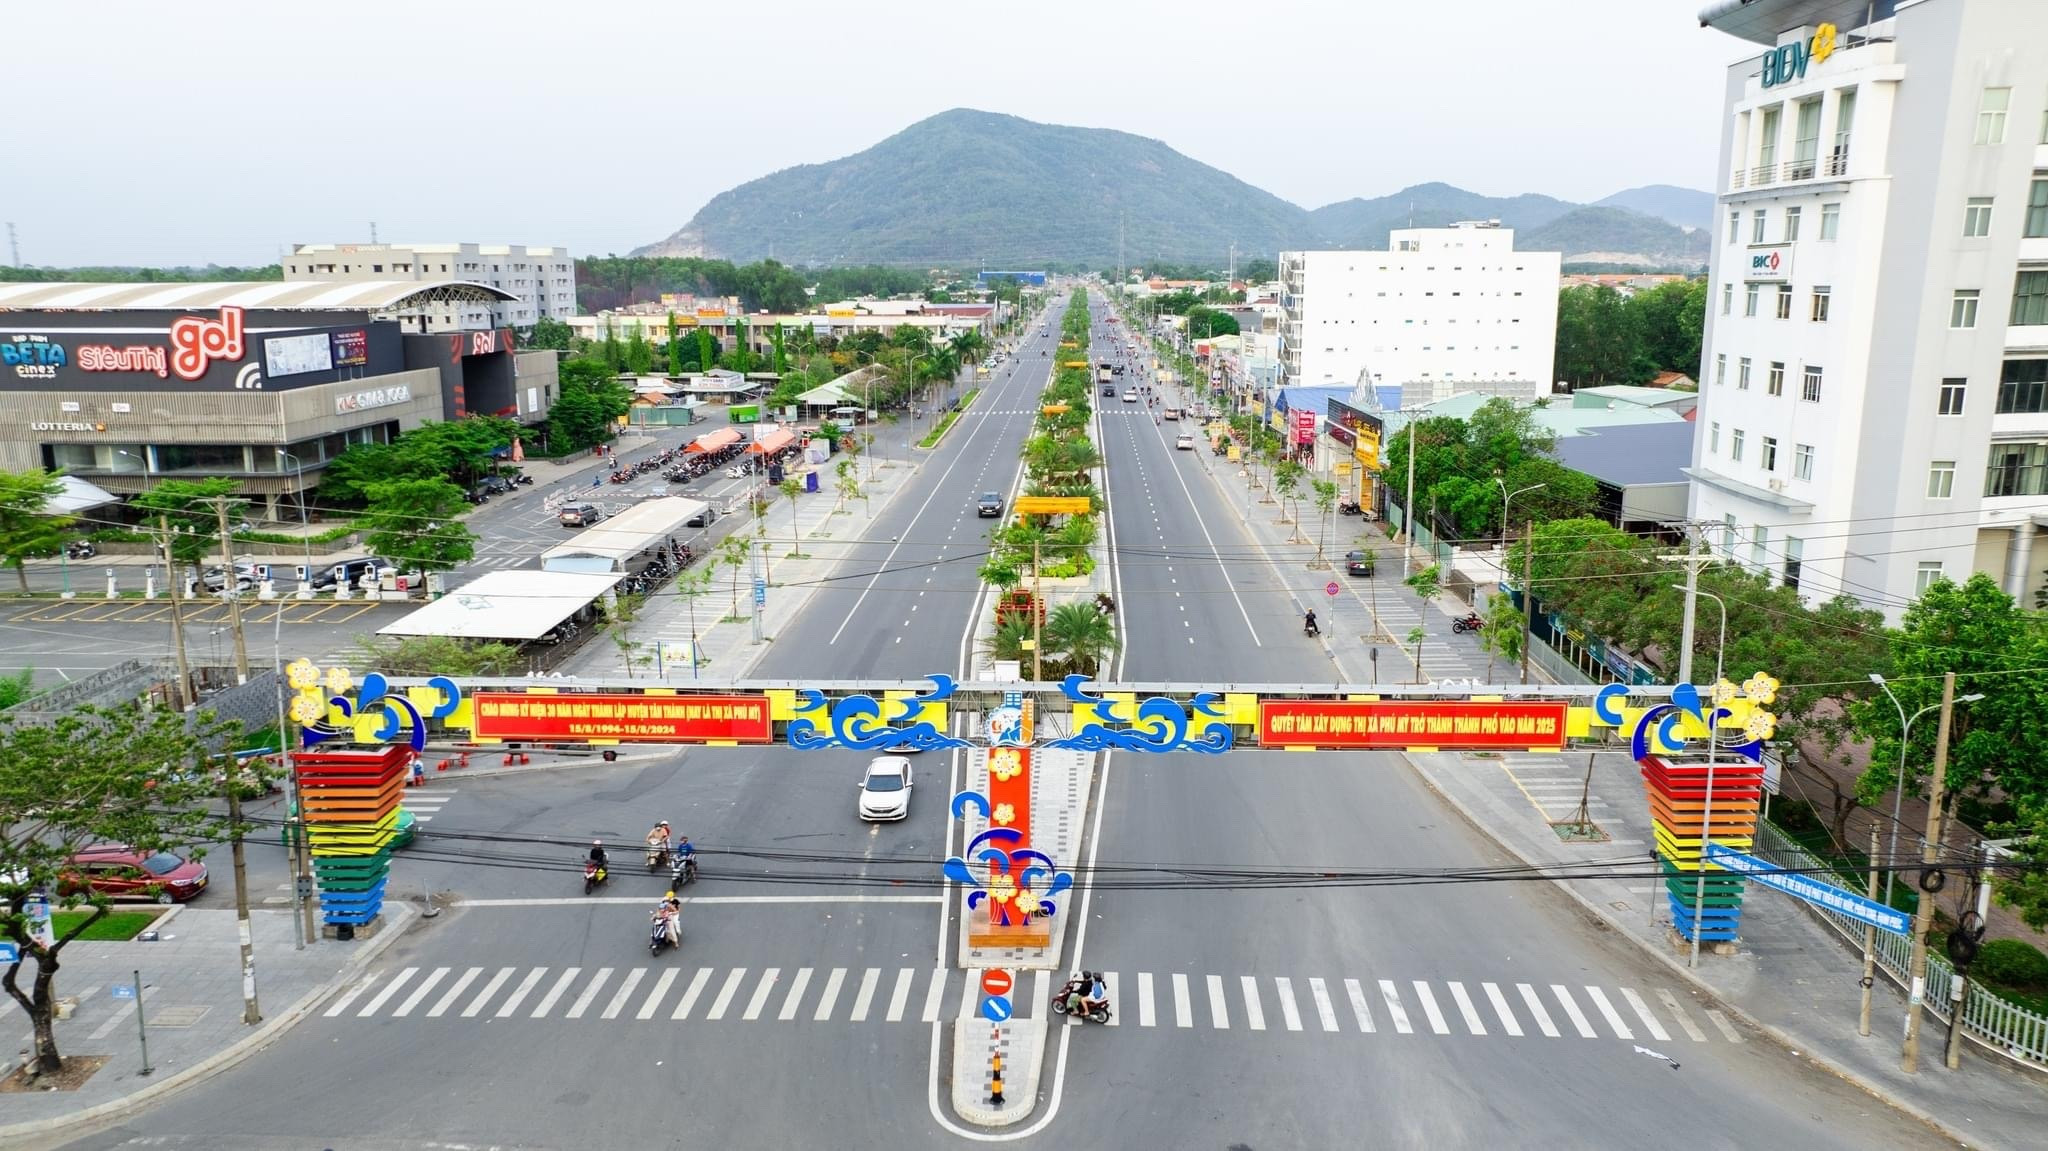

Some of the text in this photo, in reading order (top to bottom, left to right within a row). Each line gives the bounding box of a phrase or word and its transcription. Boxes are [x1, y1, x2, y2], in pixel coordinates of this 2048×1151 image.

[1761, 36, 1815, 88] BIDV
[1752, 255, 1771, 268] BIC
[172, 307, 242, 380] go!
[1, 342, 67, 367] BETA
[16, 364, 57, 374] cinex
[31, 422, 94, 432] LOTTERIA
[569, 724, 676, 735] 15/8/1994-15/8/2024
[1271, 710, 1556, 736] QUYẾT TÂM XÂY DỰNG THỊ XÃ PHÚ MỸ TRỞ THÀNH THÀNH PHỐ VÀO NĂM 2025
